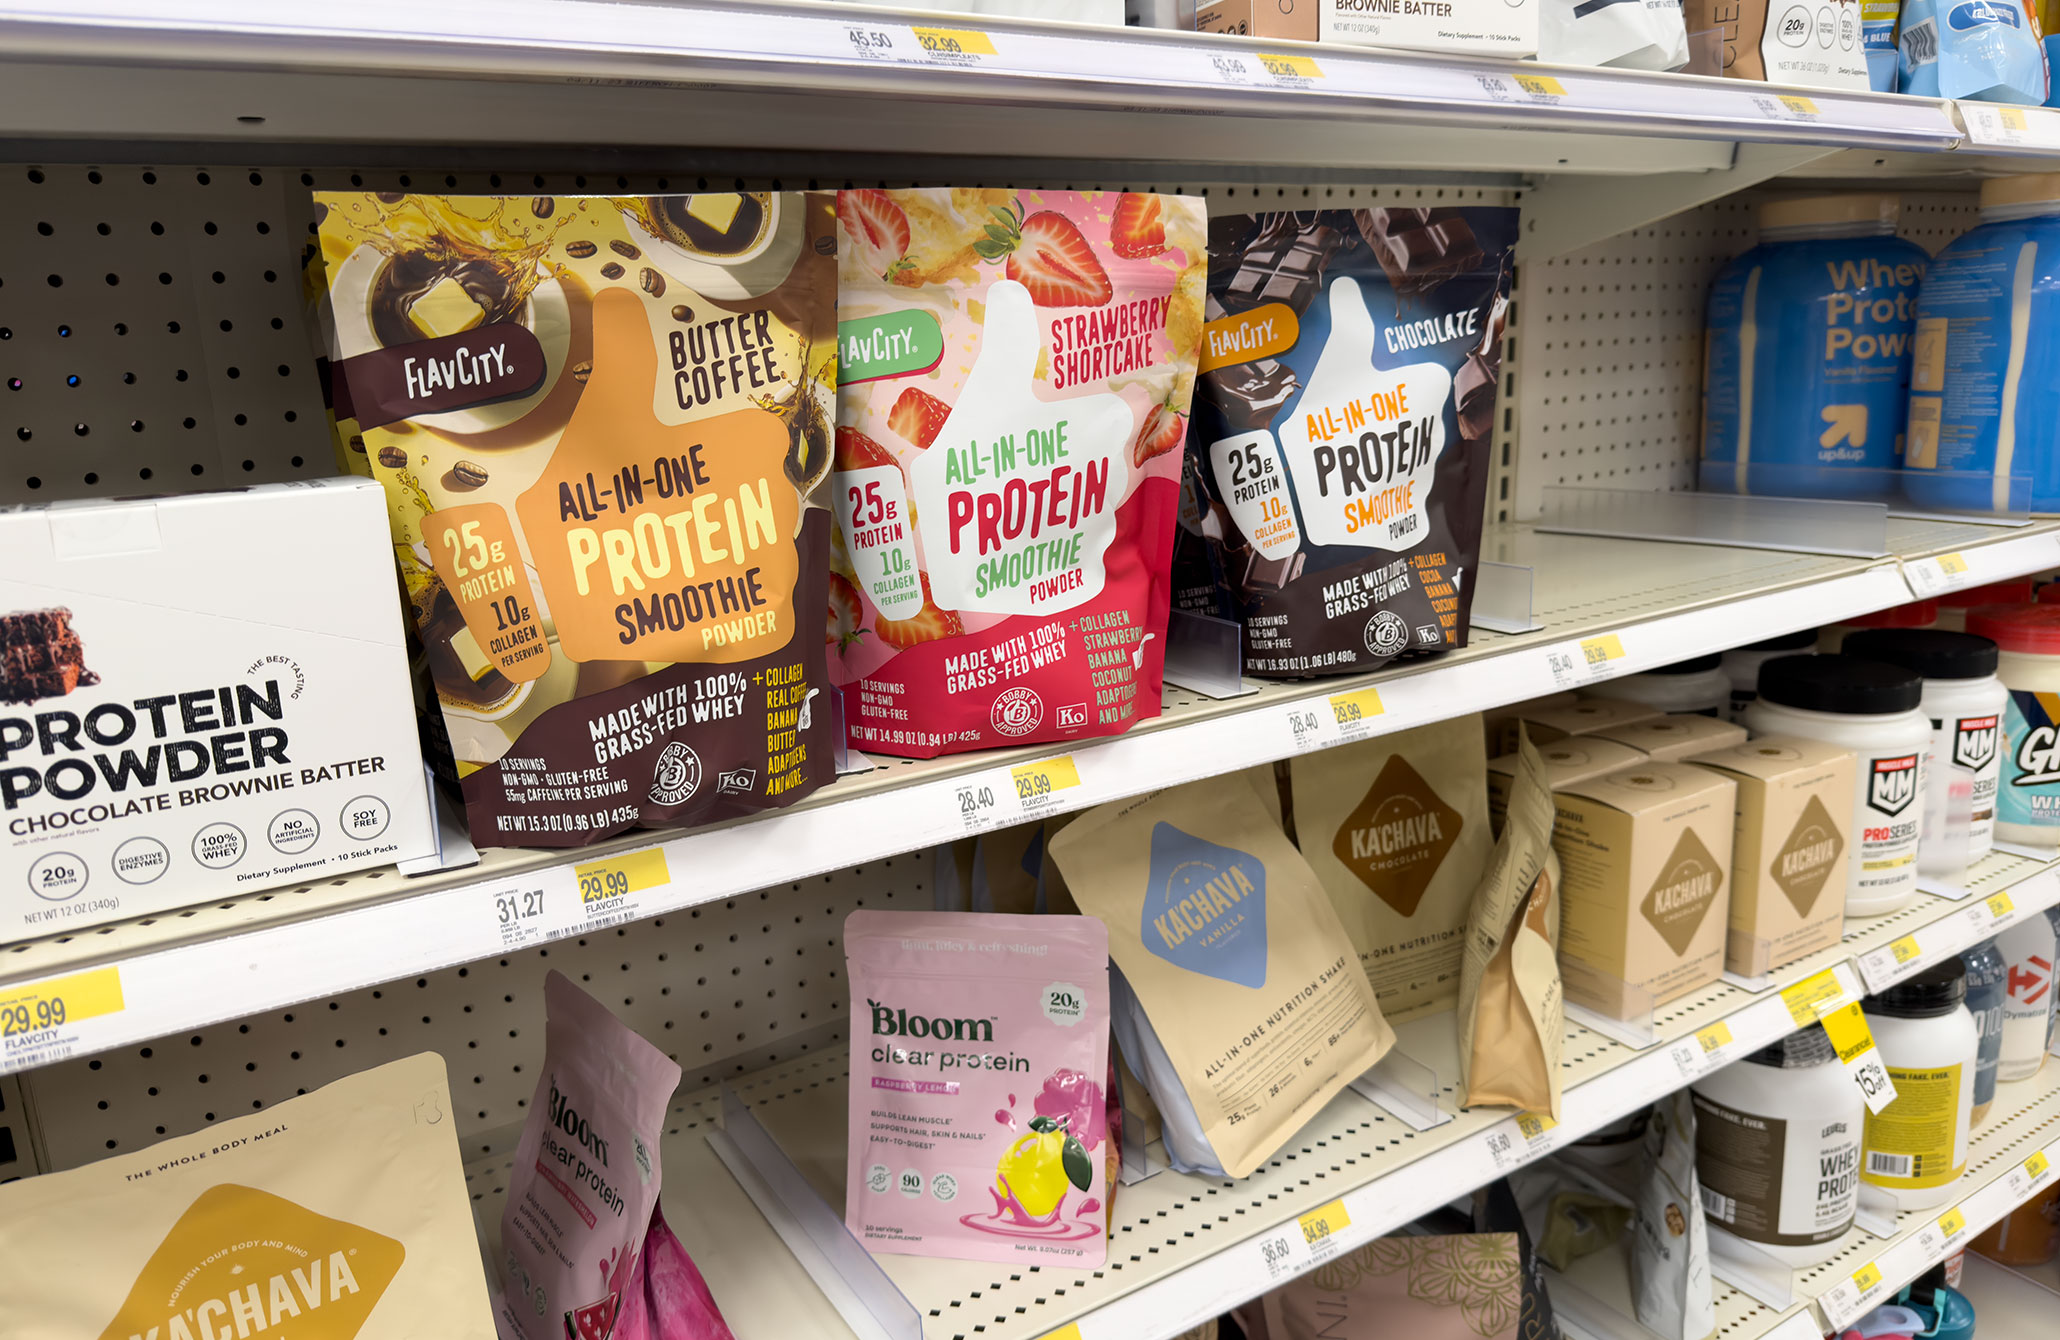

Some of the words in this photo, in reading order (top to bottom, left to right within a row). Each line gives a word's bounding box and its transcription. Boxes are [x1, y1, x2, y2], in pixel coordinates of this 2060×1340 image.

[1336, 0, 1400, 13] BROWNIE
[1404, 1, 1452, 17] BATTER
[1785, 19, 1804, 30] 20g
[850, 31, 892, 48] 45.50
[918, 36, 962, 53] 32.99
[1052, 295, 1172, 354] STRAWBERRY
[1384, 307, 1479, 354] CHOCOLATE
[669, 310, 773, 371] BUTTER
[837, 326, 913, 370] LAVCITY
[1054, 334, 1153, 389] SHORTCAKE
[674, 347, 781, 410] COFFEE
[1306, 383, 1409, 443] ALL-IN-ONE
[946, 420, 1069, 485] ALL-IN-ONE
[1228, 442, 1273, 486] 25g
[1313, 415, 1435, 497] PROTEIN
[559, 444, 710, 522] ALL-IN-ONE
[1234, 475, 1279, 505] PROTEIN
[849, 481, 898, 528] 25g
[948, 457, 1108, 555] PROTEIN
[1344, 480, 1415, 533] SMOOTHIE
[567, 478, 777, 596] PROTEIN
[854, 522, 903, 550] PROTEIN
[1388, 513, 1418, 541] POWDER
[444, 520, 505, 578] 25g
[880, 548, 911, 576] 10g
[976, 532, 1084, 598] SMOOTHIE
[460, 564, 516, 605] PROTEIN
[873, 575, 915, 595] COLLAGEN
[1030, 568, 1084, 604] POWDER
[490, 595, 531, 632] 10g
[615, 567, 767, 645] SMOOTHIE
[701, 610, 777, 651] POWDER
[1080, 610, 1130, 632] COLLAGEN
[490, 625, 538, 655] COLLAGEN
[945, 655, 988, 676] MADE
[991, 638, 1027, 661] WITH
[1029, 621, 1066, 649] 100%
[1083, 626, 1143, 651] STRAWBERRY
[501, 655, 515, 667] PER
[514, 643, 544, 662] SERVING
[947, 658, 1030, 694] GRASS-FED
[1033, 640, 1067, 670] WHEY
[1088, 649, 1127, 669] BANANA
[247, 660, 265, 676] THE
[265, 655, 290, 665] BEST
[290, 662, 305, 700] TASTING
[1091, 666, 1133, 688] COCONUT
[588, 707, 641, 742] MADE
[641, 689, 687, 718] WITH
[694, 671, 747, 701] 100%
[767, 707, 798, 731] BANANA
[1333, 702, 1362, 724] 29.99
[0, 680, 283, 762] PROTEIN
[595, 709, 687, 765] GRASS-FED
[693, 693, 745, 724] WHEY
[996, 717, 1040, 735] APPROVED
[1289, 712, 1319, 734] 28.40
[0, 727, 292, 811] POWDER
[503, 772, 539, 786] NON-GMO
[545, 766, 609, 785] GLUTEN-FREE
[9, 794, 172, 836] CHOCOLATE
[178, 772, 295, 806] BROWNIE
[301, 756, 386, 785] BATTER
[505, 789, 526, 804] 55mg
[526, 785, 565, 803] CAFFEINE
[565, 787, 582, 801] PER
[583, 778, 628, 799] SERVING
[958, 786, 995, 813] 28.40
[1016, 773, 1051, 799] 29.99
[353, 809, 376, 821] SOY
[1021, 794, 1050, 808] FLAVCITY
[283, 820, 302, 830] NO
[354, 818, 378, 828] FREE
[497, 815, 513, 832] NET
[513, 815, 526, 831] WT
[527, 815, 549, 832] 15.3
[550, 814, 562, 831] OZ
[562, 812, 589, 832] (0.96
[589, 809, 610, 831] LB)
[611, 805, 639, 825] 435g
[200, 832, 237, 847] 100%
[275, 827, 313, 839] ARTIFICIAL
[275, 833, 315, 845] INGREDIENTS
[118, 852, 163, 865] DIGESTIVE
[119, 857, 164, 872] ENZYMES
[203, 847, 238, 860] WHEY
[237, 869, 271, 882] Dietary
[273, 858, 326, 875] Supplement
[338, 853, 349, 861] 10
[350, 848, 372, 859] Stick
[374, 844, 398, 854] Packs
[1370, 849, 1430, 871] CHOCOLATE
[42, 866, 75, 883] 20g
[43, 878, 77, 889] PROTEIN
[580, 870, 629, 904] 29.99
[24, 911, 43, 924] NET
[43, 909, 59, 922] WT
[60, 906, 73, 918] 12
[74, 903, 87, 914] OZ
[88, 896, 120, 913] (340g)
[496, 889, 544, 923] 31.27
[585, 897, 625, 914] FLAVCITY
[1200, 912, 1245, 948] VANILLA
[1400, 929, 1455, 950] NUTRITION
[1050, 992, 1079, 1009] 20g
[1, 997, 66, 1037] 29.99
[869, 1003, 994, 1042] Bloom
[1204, 1025, 1266, 1079] ALL-IN-ONE
[1266, 981, 1319, 1028] NUTRITION
[1319, 956, 1347, 984] SHAKE
[5, 1029, 59, 1050] FLAVCITY
[872, 1044, 934, 1064] clear
[940, 1052, 1030, 1073] protein
[125, 1169, 152, 1182] THE
[157, 1151, 207, 1172] WHOLE
[211, 1137, 249, 1155] BODY
[253, 1124, 289, 1142] MEAL
[575, 1158, 625, 1217] protein
[902, 1174, 920, 1187] 90
[1302, 1218, 1330, 1244] 34.99
[1262, 1237, 1290, 1263] 36.60
[168, 1265, 201, 1308] NOURISH
[200, 1249, 229, 1268] YOUR
[231, 1239, 261, 1253] BODY
[261, 1239, 284, 1250] AND
[284, 1244, 309, 1258] MIND
